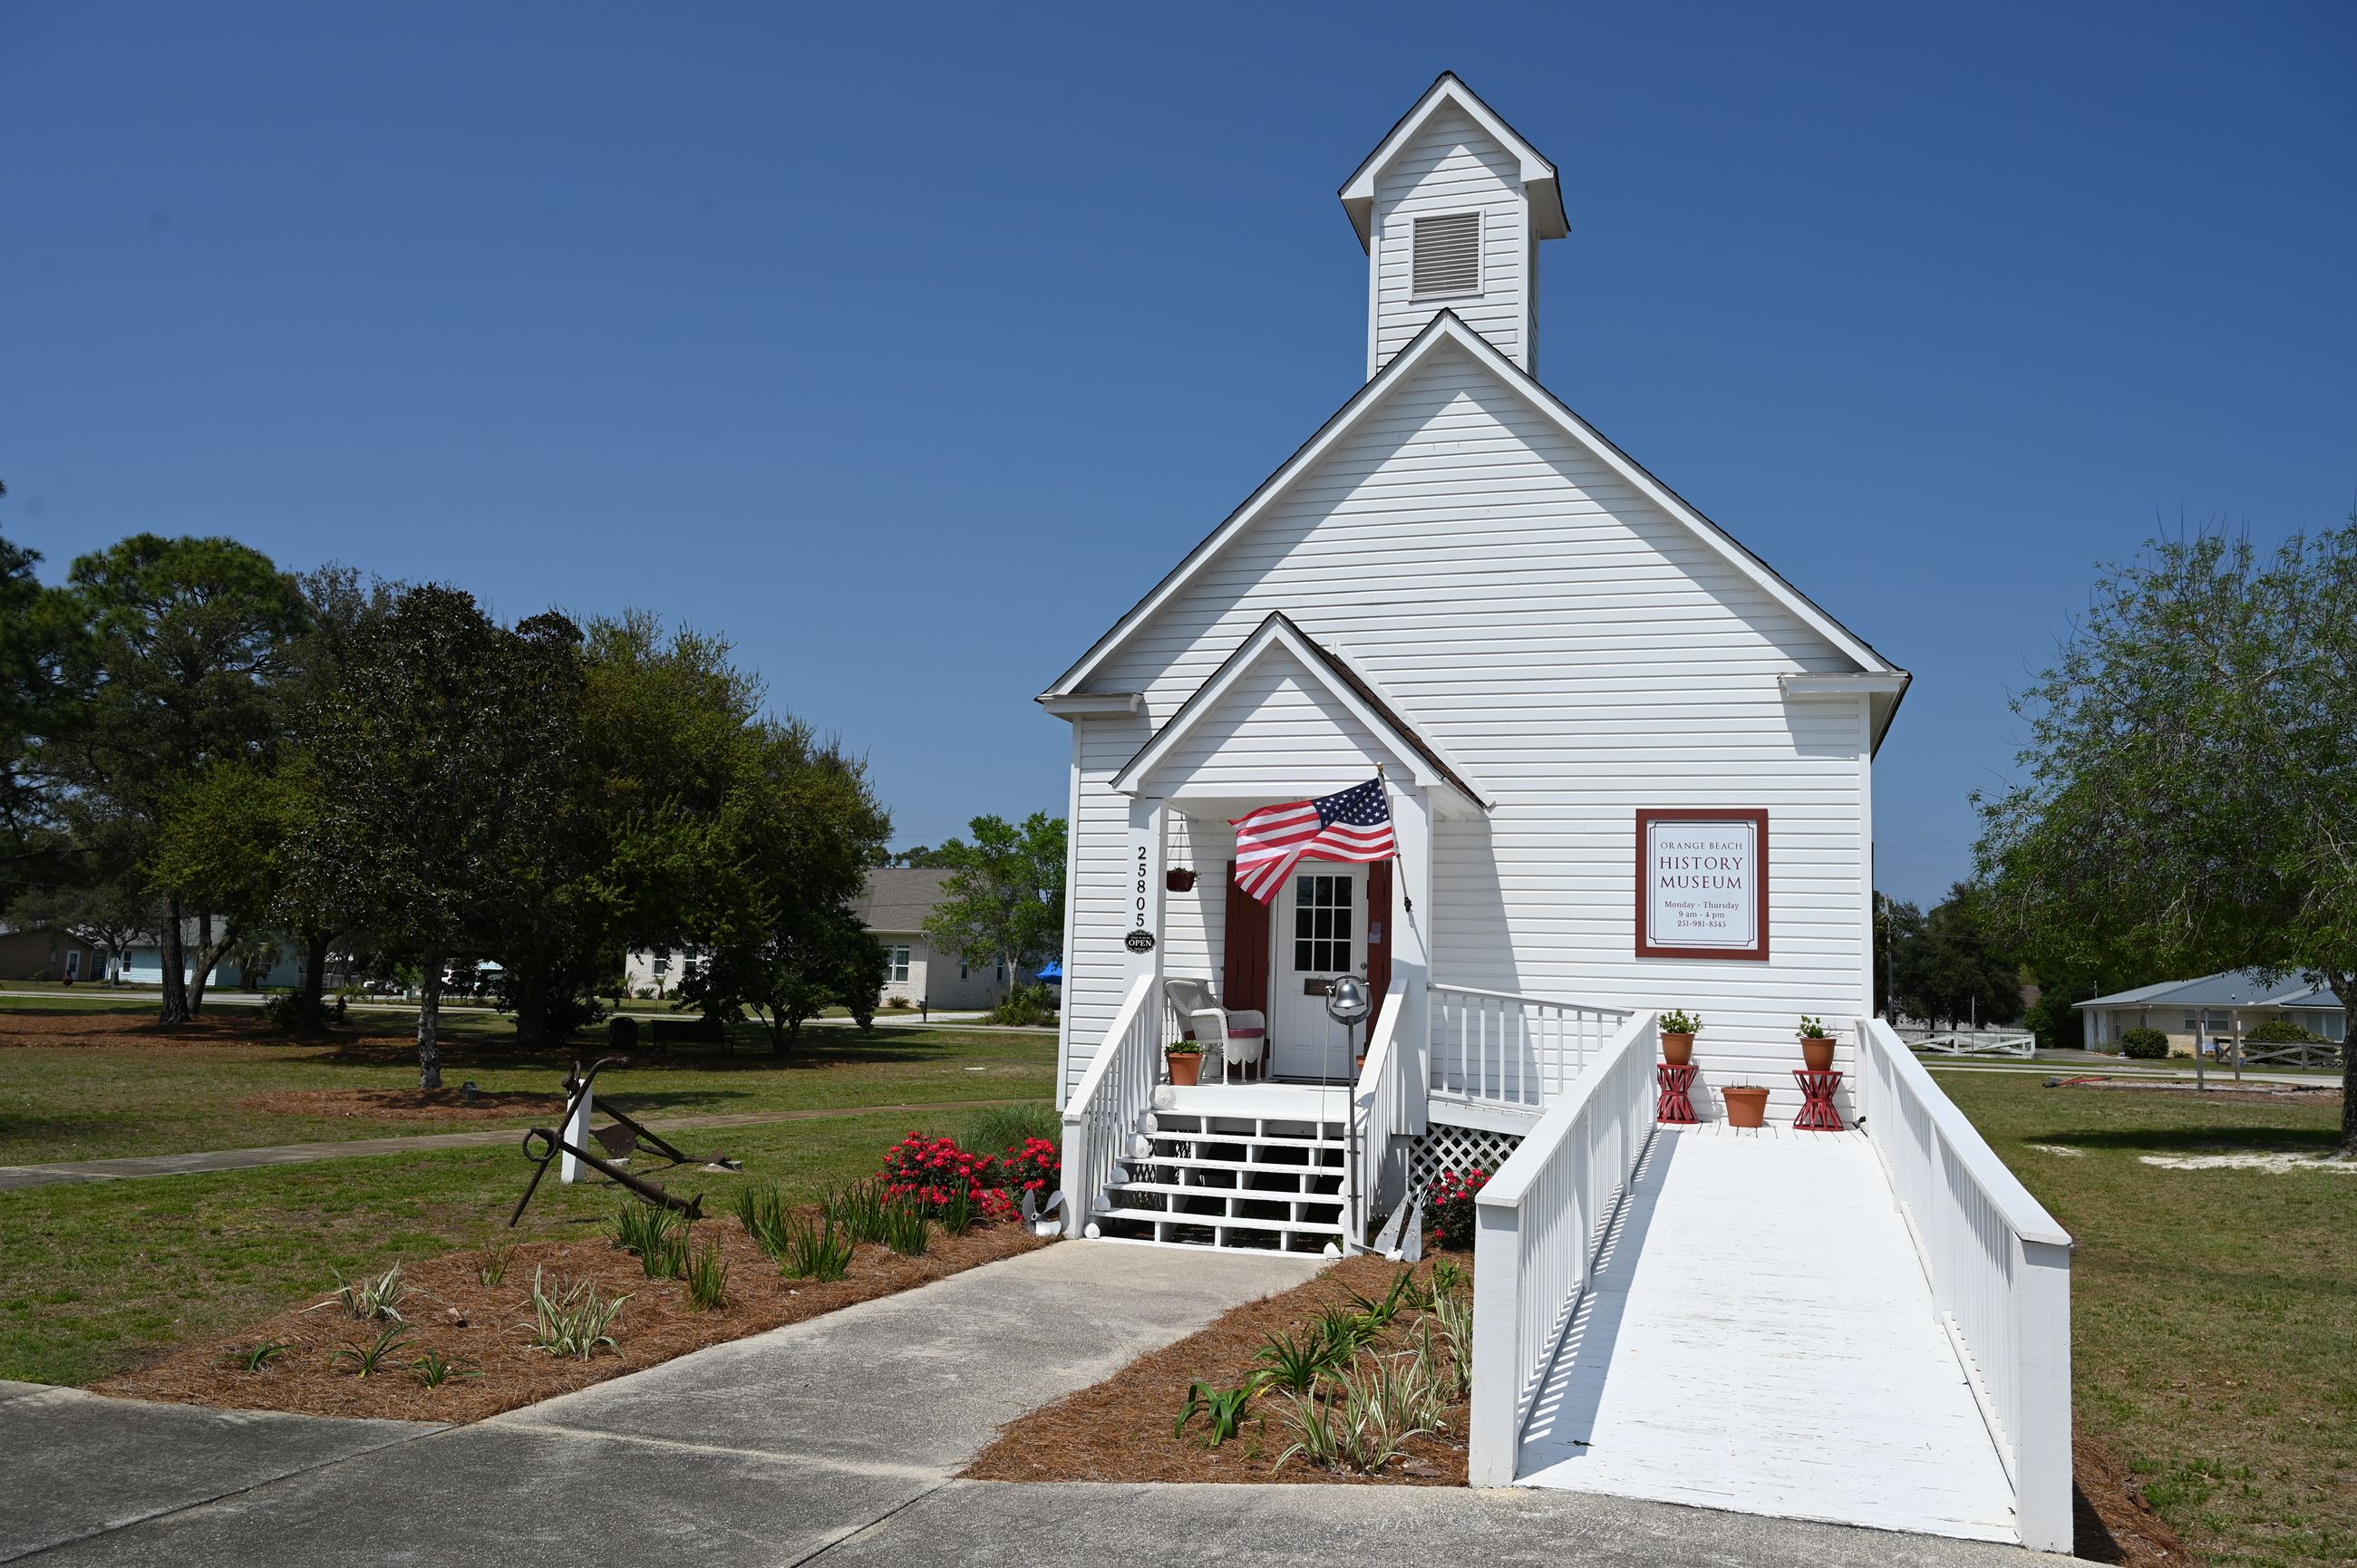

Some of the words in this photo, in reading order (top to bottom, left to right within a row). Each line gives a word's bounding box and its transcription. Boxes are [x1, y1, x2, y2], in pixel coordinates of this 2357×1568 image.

[1661, 857, 1742, 870] HISTORY
[1136, 847, 1146, 926] 25805
[1661, 876, 1741, 888] MUSEUM
[1664, 901, 1695, 909] Monday
[1702, 902, 1739, 910] Thursday
[1677, 920, 1726, 928] 251-981-8545
[1128, 939, 1152, 947] OPEN
